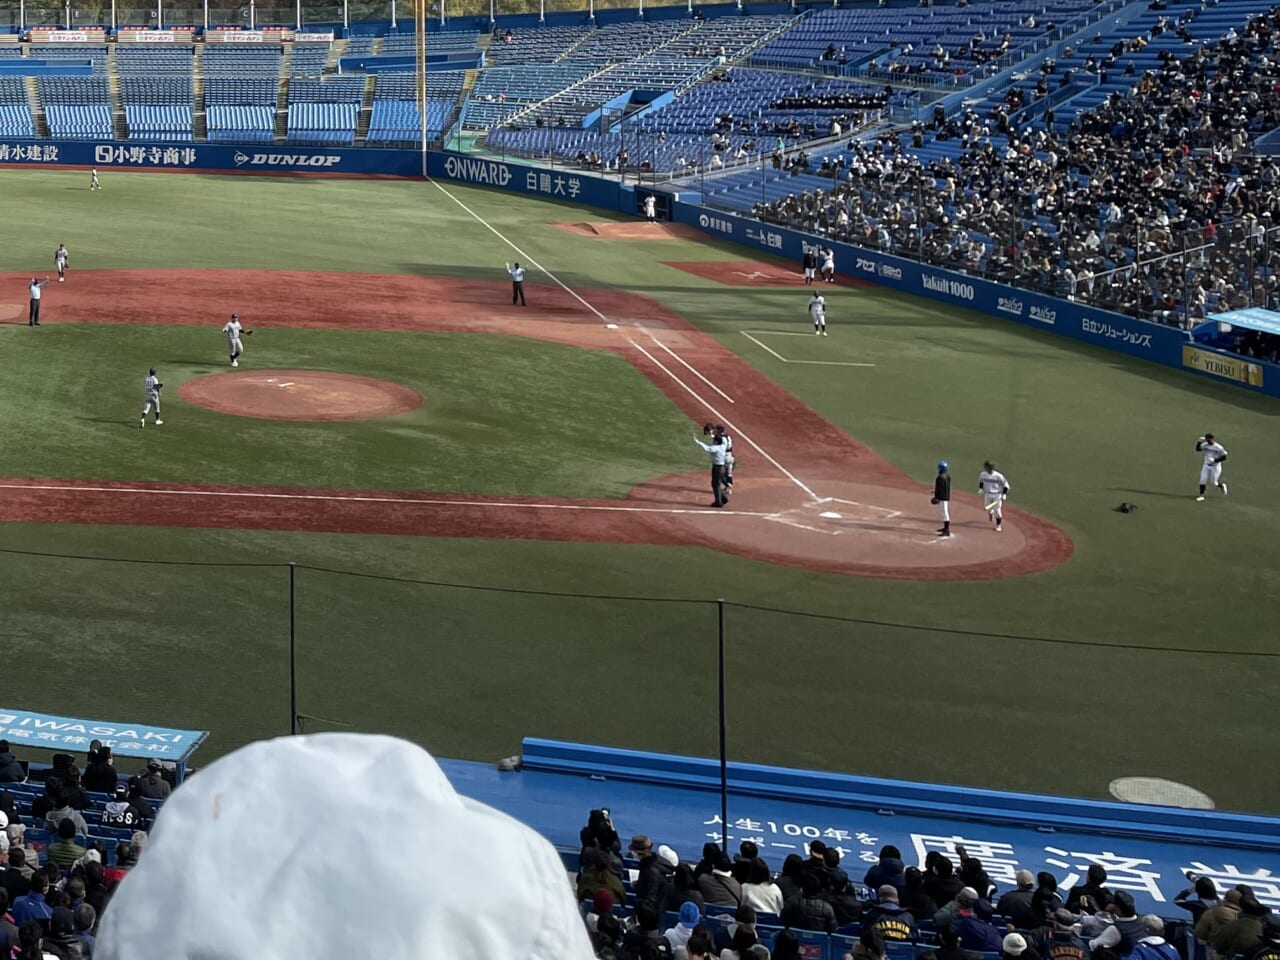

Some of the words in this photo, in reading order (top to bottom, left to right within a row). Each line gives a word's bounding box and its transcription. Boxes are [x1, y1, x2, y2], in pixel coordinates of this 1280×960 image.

[113, 146, 197, 165] 小野寺商事
[250, 154, 341, 167] DUNLOP
[445, 156, 512, 186] ONWARD
[1082, 318, 1152, 348] 日立ソリューションズ
[1205, 359, 1235, 377] YEBISU
[19, 717, 185, 743] IWASAKI
